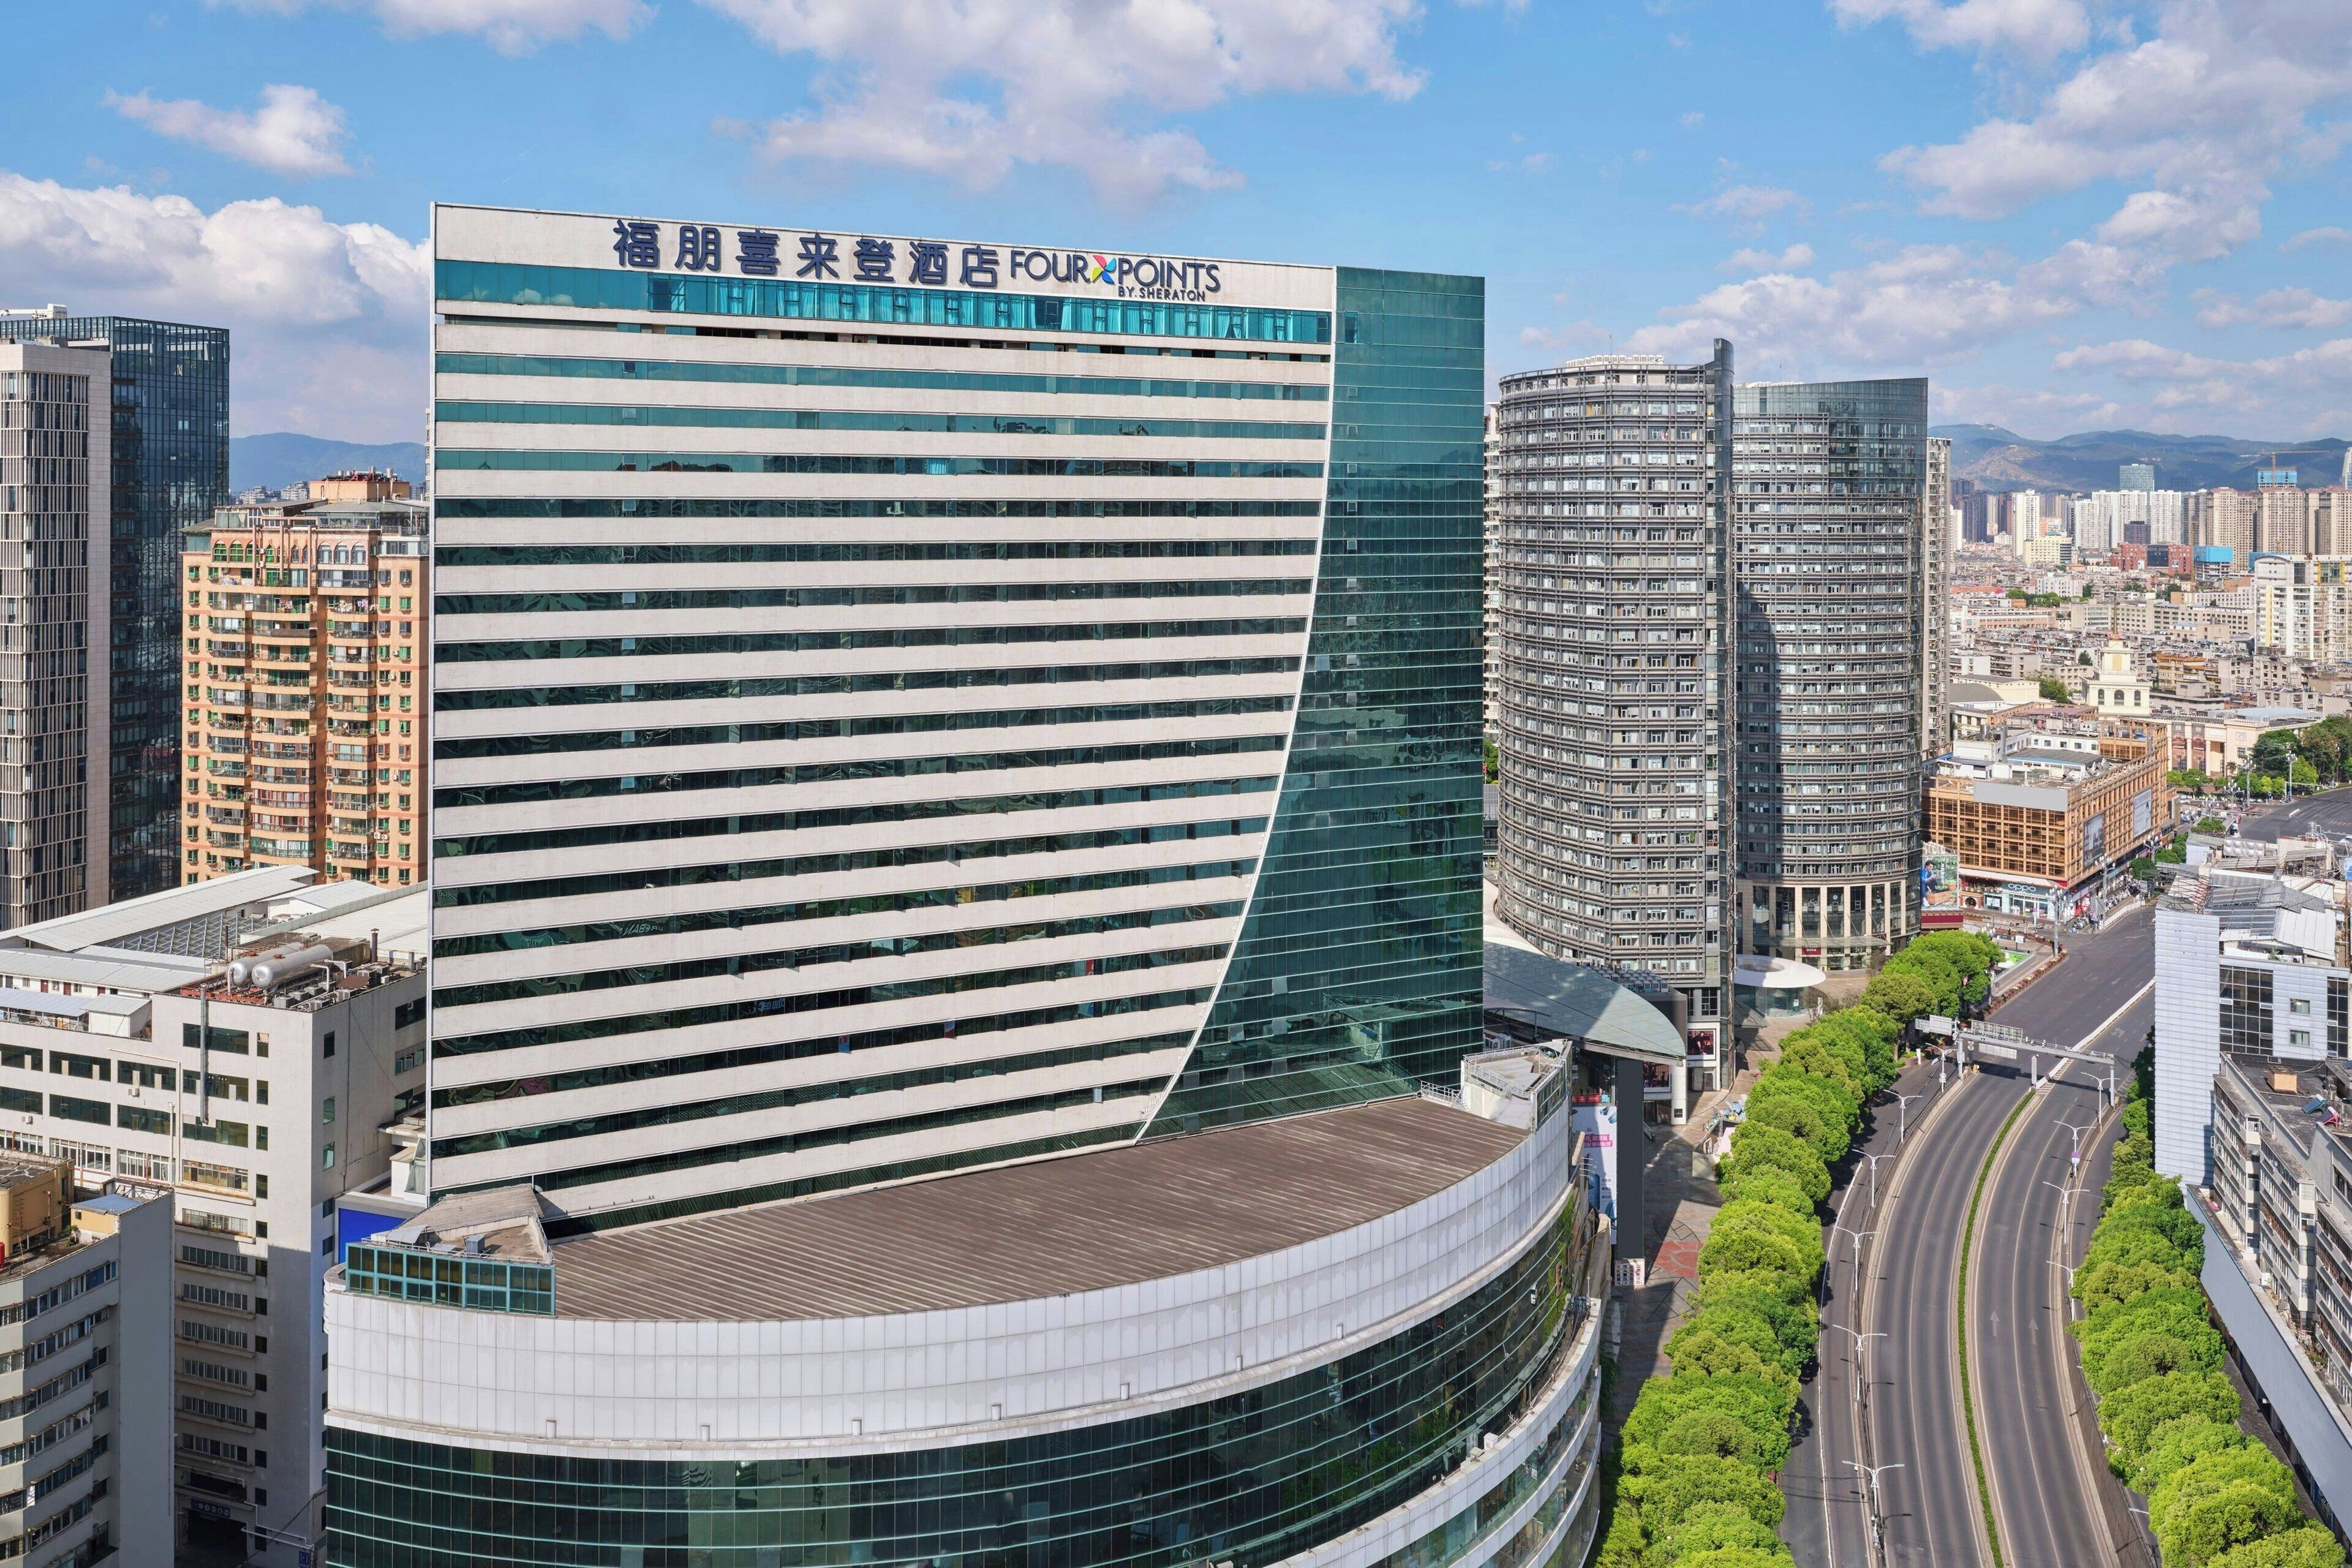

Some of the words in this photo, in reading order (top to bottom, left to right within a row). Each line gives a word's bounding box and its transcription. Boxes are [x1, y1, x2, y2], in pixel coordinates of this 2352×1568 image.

[613, 219, 1000, 287] 福朋喜来登酒店
[1011, 250, 1090, 282] FOUR
[1118, 258, 1221, 292] POINTS
